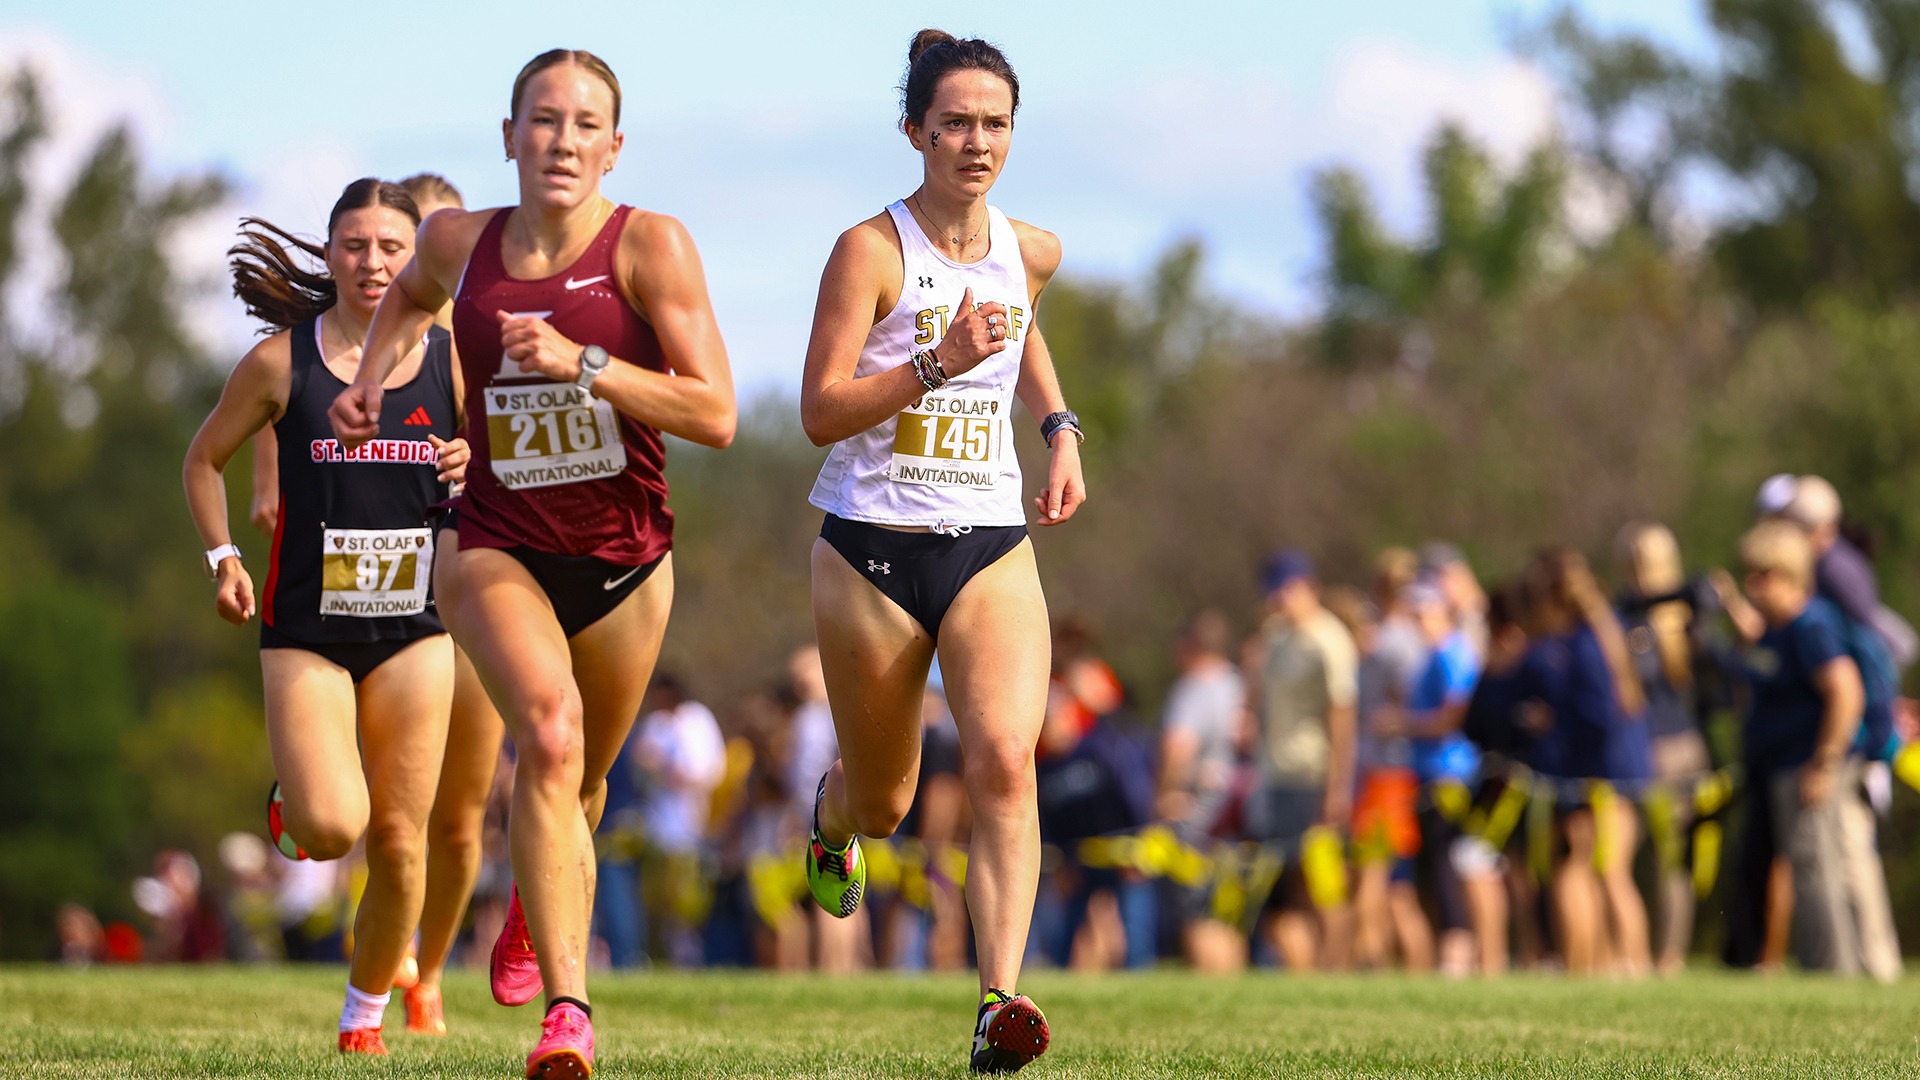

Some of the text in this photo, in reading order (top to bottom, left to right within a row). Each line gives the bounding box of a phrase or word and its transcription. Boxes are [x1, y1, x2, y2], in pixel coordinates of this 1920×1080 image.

[510, 393, 535, 410] ST.
[924, 396, 989, 415] ST. OLAF
[510, 408, 596, 459] 216
[921, 416, 989, 461] 145
[311, 440, 342, 462] ST.
[503, 459, 618, 486] INVITATIONAL
[900, 465, 993, 486] INVITATIONAL
[348, 537, 412, 550] ST. OLAF
[355, 553, 403, 591] 97
[330, 599, 418, 613] INVITATIONAL
